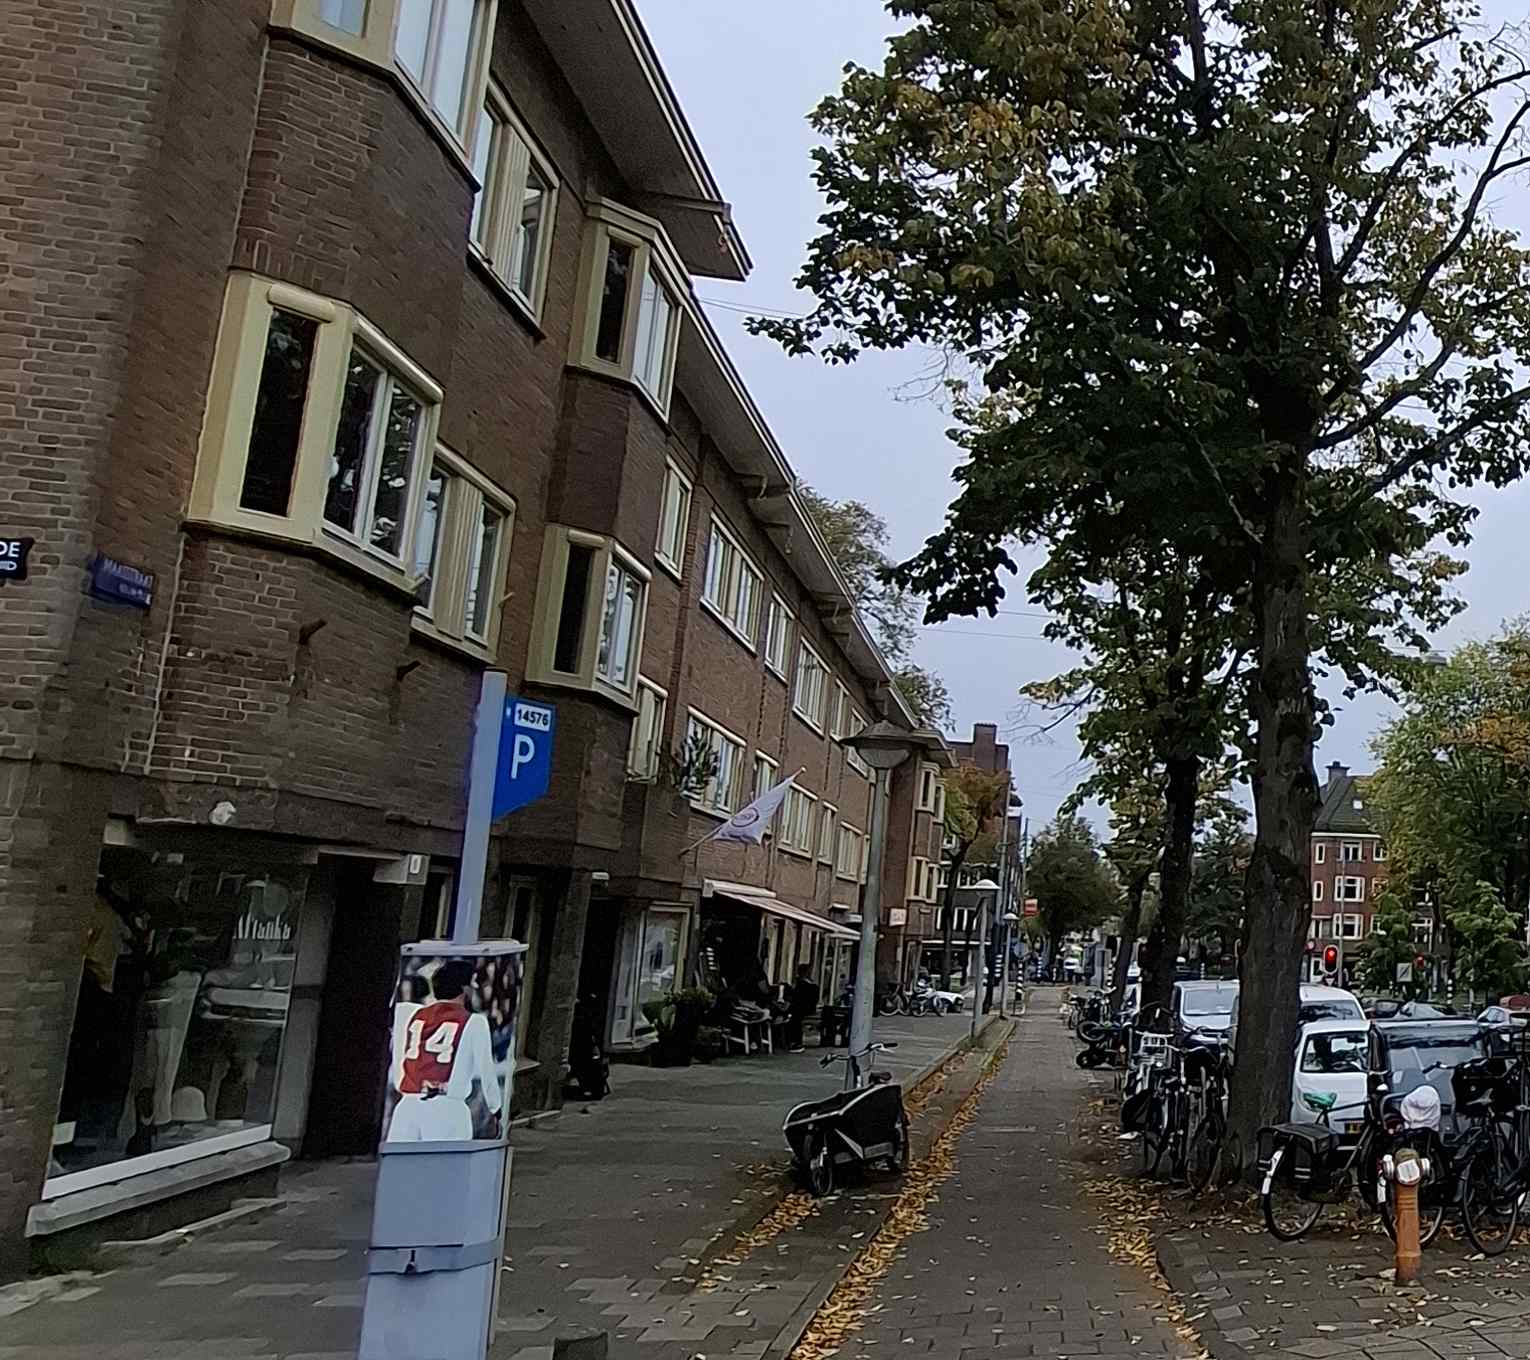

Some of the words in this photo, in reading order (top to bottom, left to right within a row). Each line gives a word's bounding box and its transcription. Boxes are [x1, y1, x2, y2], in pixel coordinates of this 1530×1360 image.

[517, 708, 549, 727] 14576
[511, 733, 535, 779] P
[406, 1019, 459, 1064] 14
